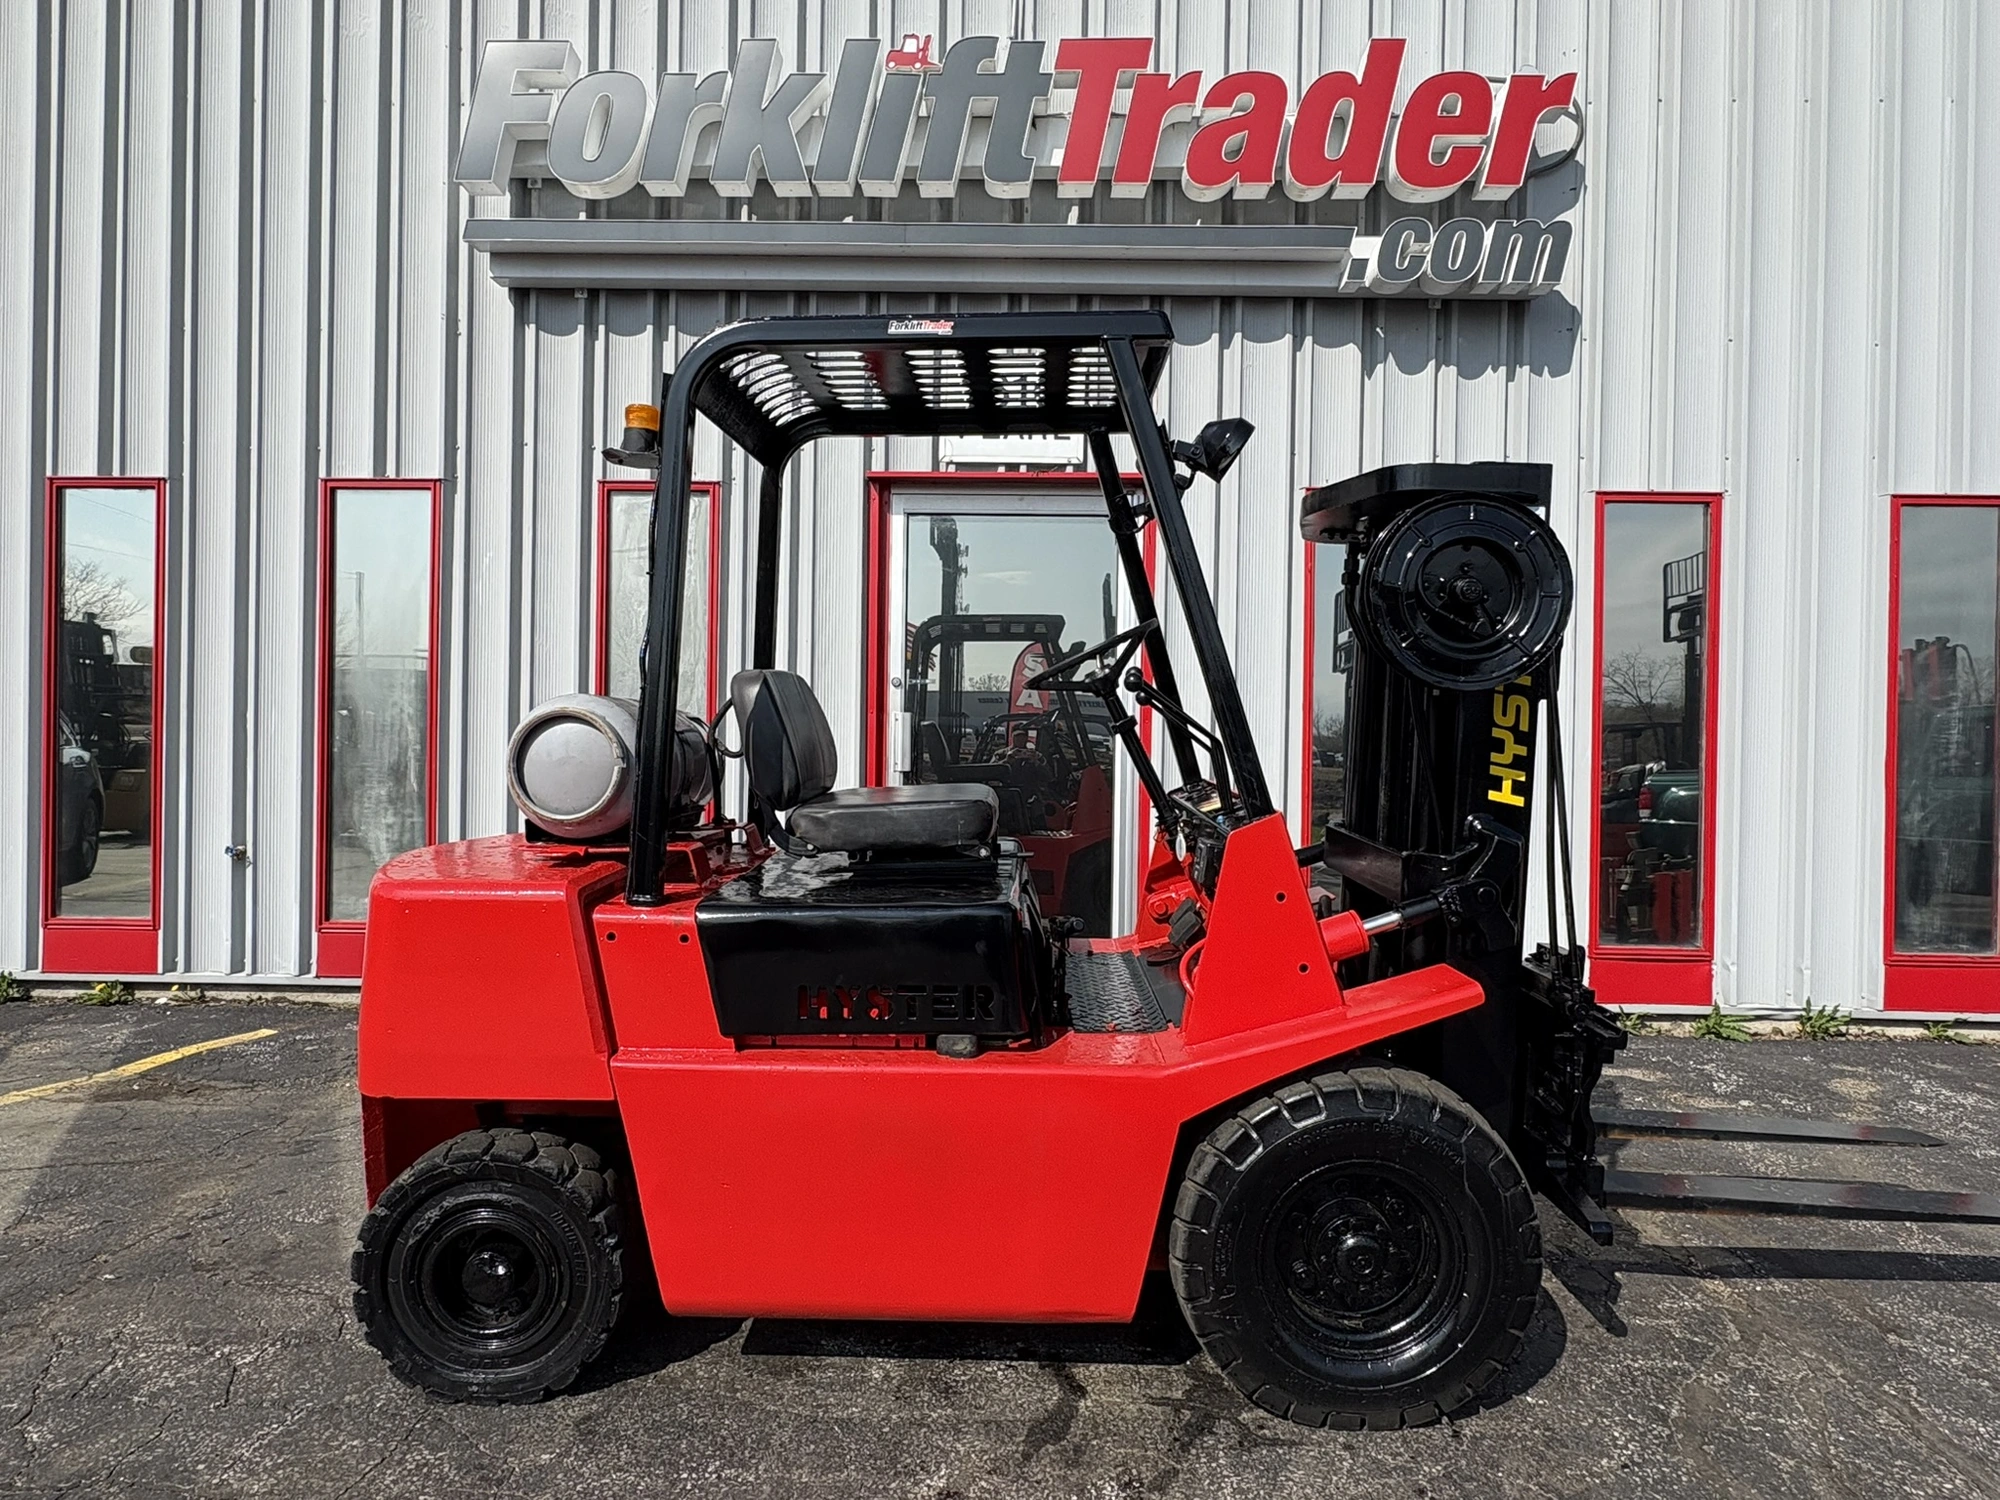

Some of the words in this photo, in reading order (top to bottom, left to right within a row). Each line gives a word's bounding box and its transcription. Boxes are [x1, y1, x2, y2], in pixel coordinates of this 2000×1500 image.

[455, 35, 1577, 194] ForkliftTrader
[1341, 217, 1574, 290] .com
[889, 320, 954, 331] ForkliftTrader
[799, 984, 995, 1021] HYSTER
